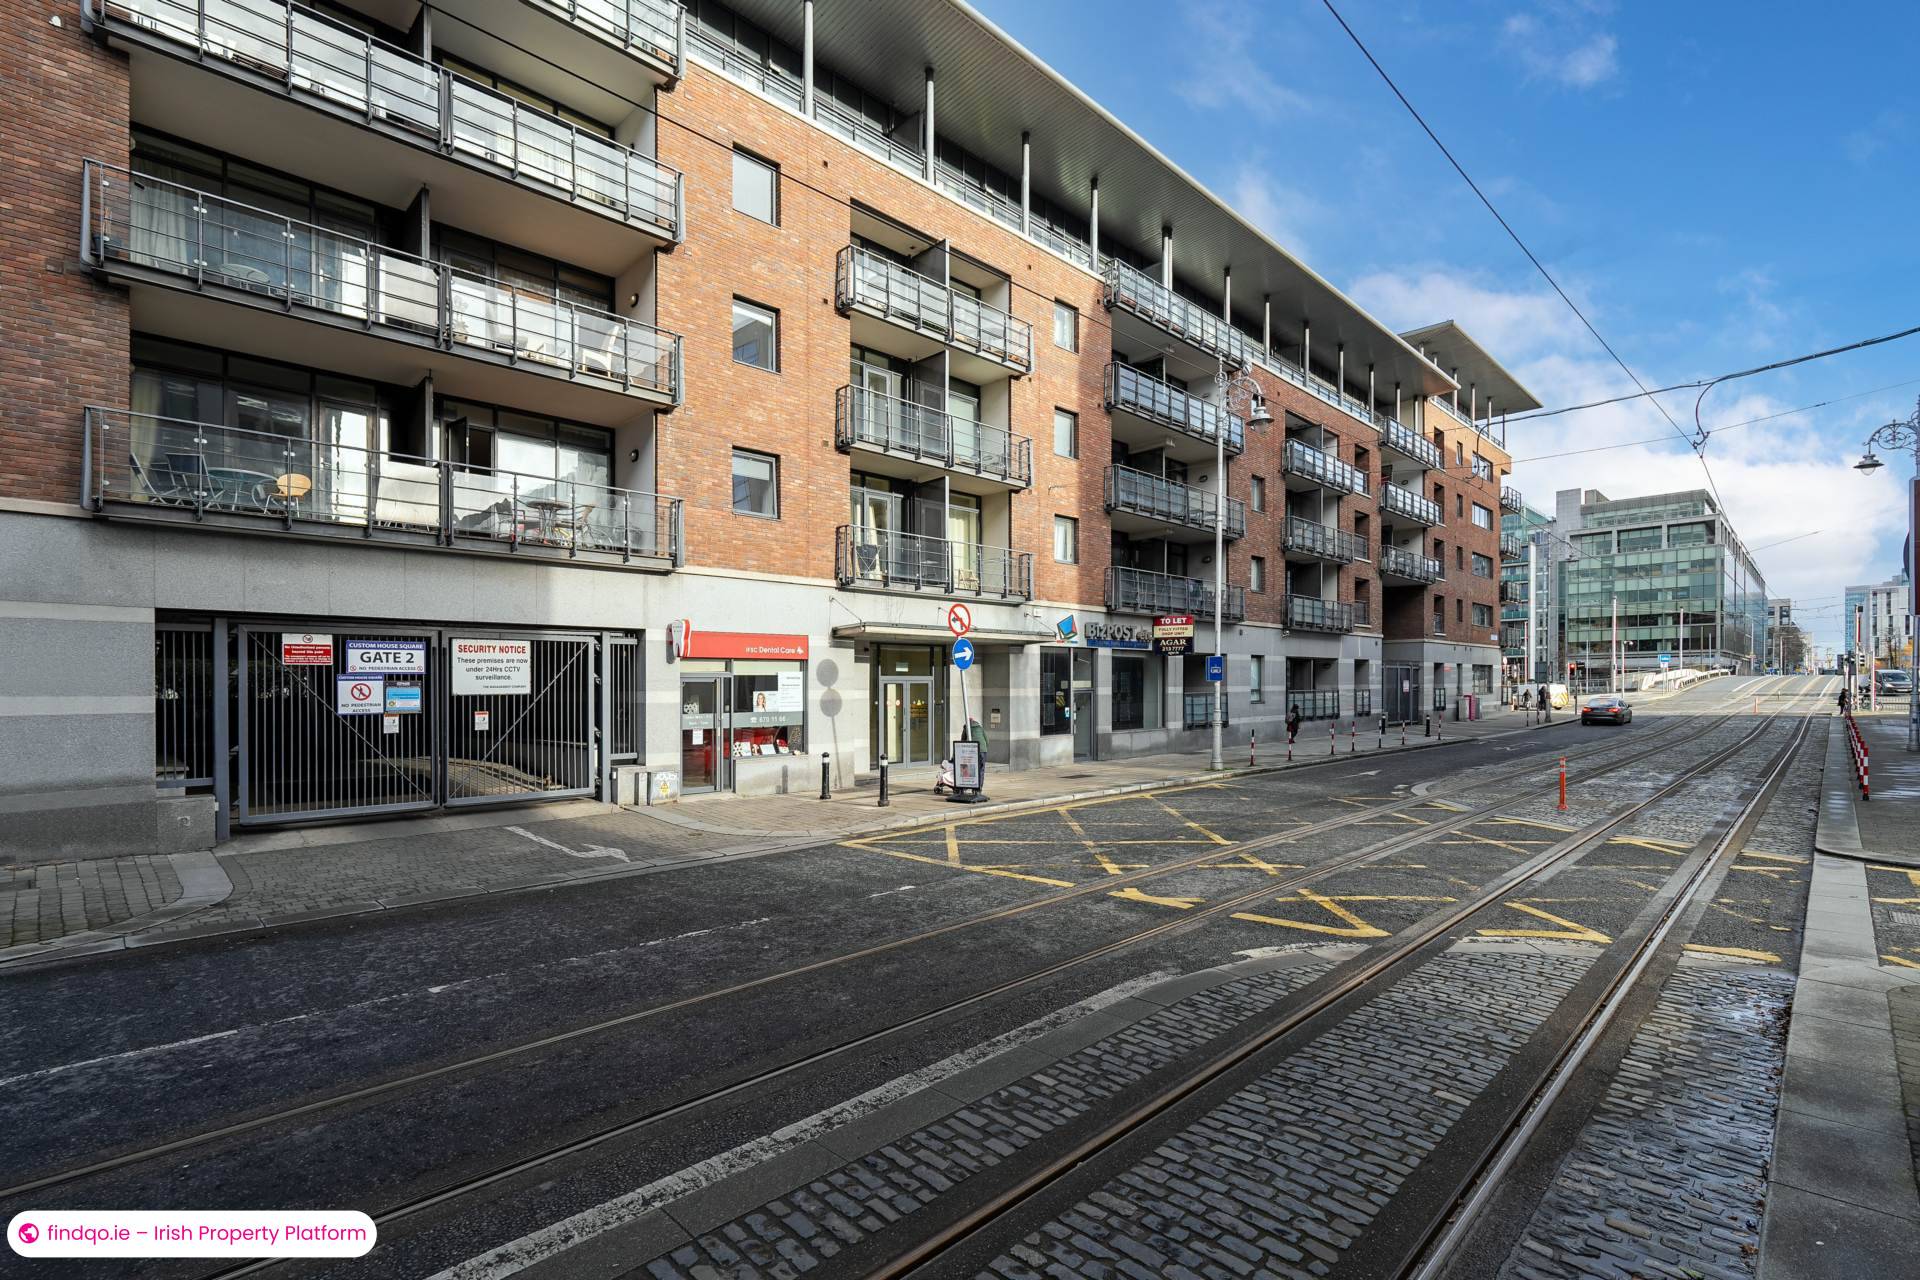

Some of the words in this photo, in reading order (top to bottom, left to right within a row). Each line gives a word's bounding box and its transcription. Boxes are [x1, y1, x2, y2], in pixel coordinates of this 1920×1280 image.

[458, 644, 497, 653] SECURITY
[498, 645, 527, 654] NOTICE
[360, 651, 402, 664] GATE
[405, 652, 415, 664] 2
[457, 656, 476, 664] These
